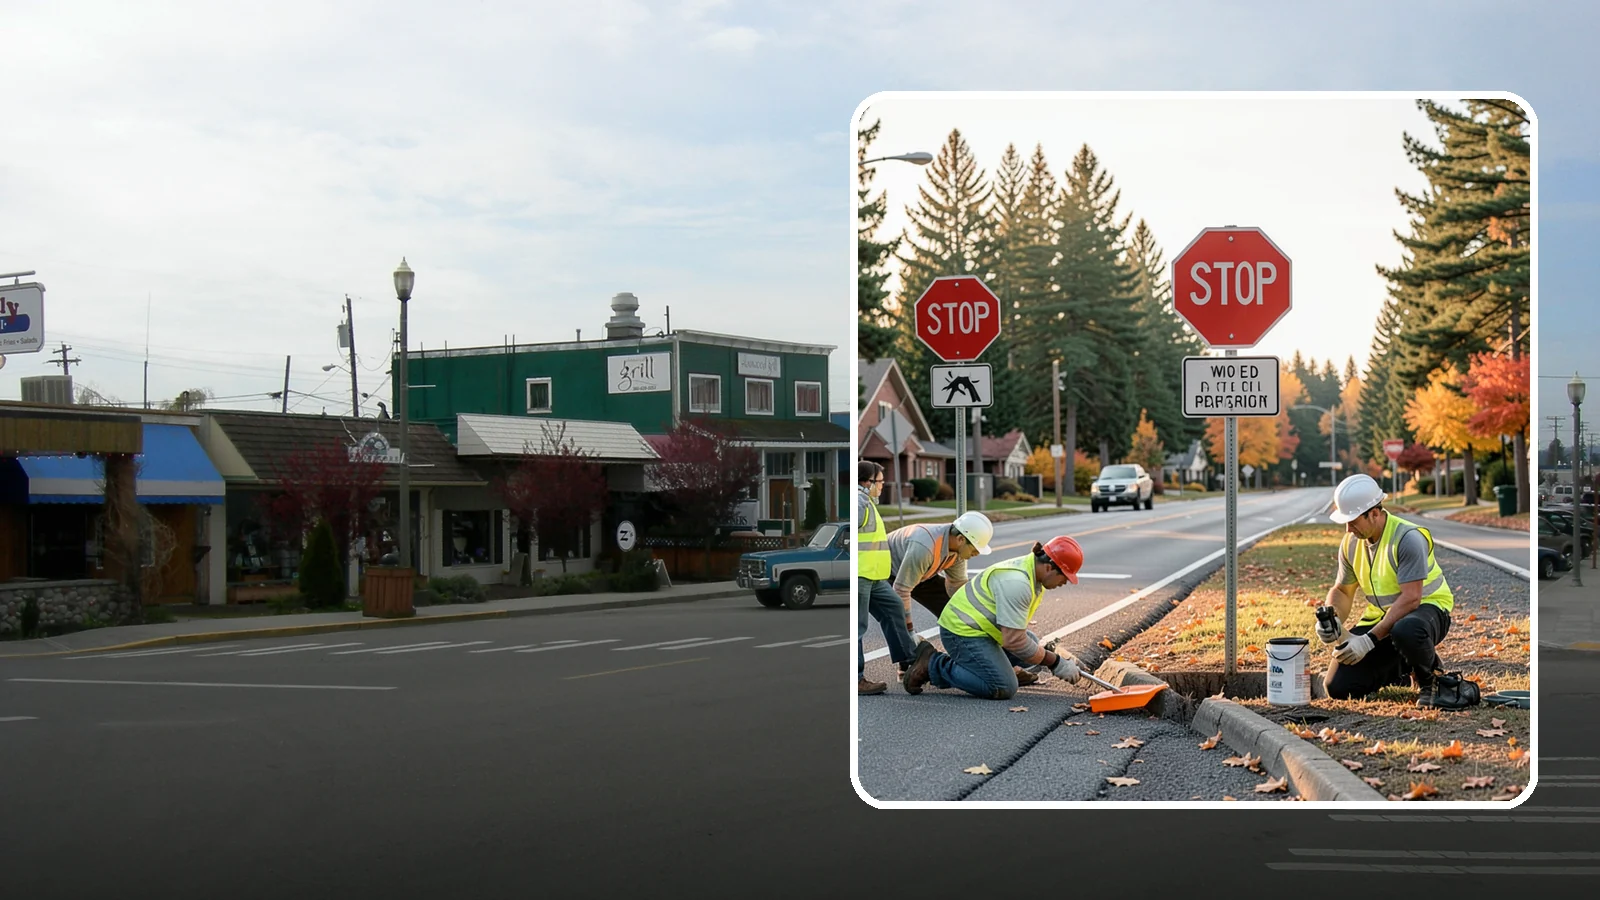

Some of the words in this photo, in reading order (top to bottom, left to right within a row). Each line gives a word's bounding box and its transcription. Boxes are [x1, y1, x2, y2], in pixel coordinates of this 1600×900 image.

[1189, 261, 1277, 306] STOP
[927, 301, 990, 335] STOP
[20, 337, 38, 345] Salads
[618, 356, 654, 391] grill
